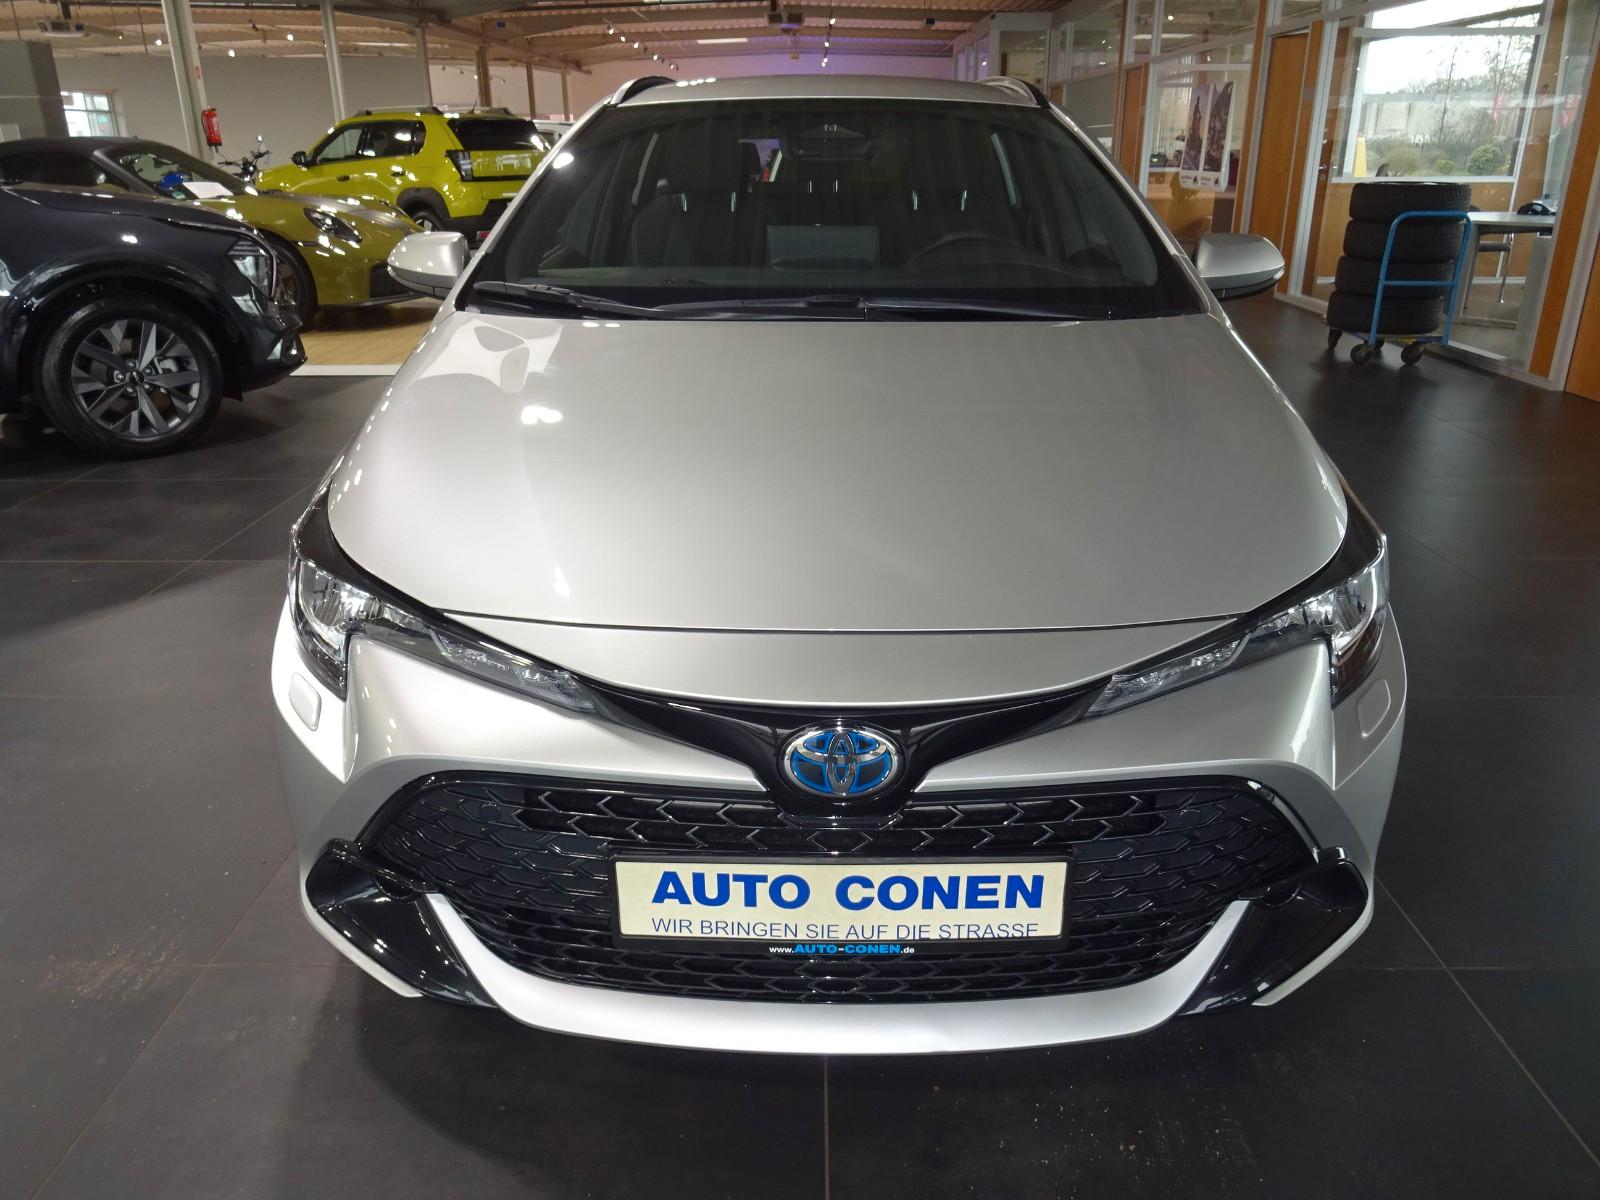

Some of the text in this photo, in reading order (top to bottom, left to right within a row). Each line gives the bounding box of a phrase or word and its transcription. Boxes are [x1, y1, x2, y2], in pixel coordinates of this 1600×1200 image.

[652, 870, 1045, 911] AUTO CONEN
[651, 917, 1039, 940] WIR BRINGEN SIE AUF DIE STRASSE
[768, 943, 915, 954] www.AUTO-CONEN.de
